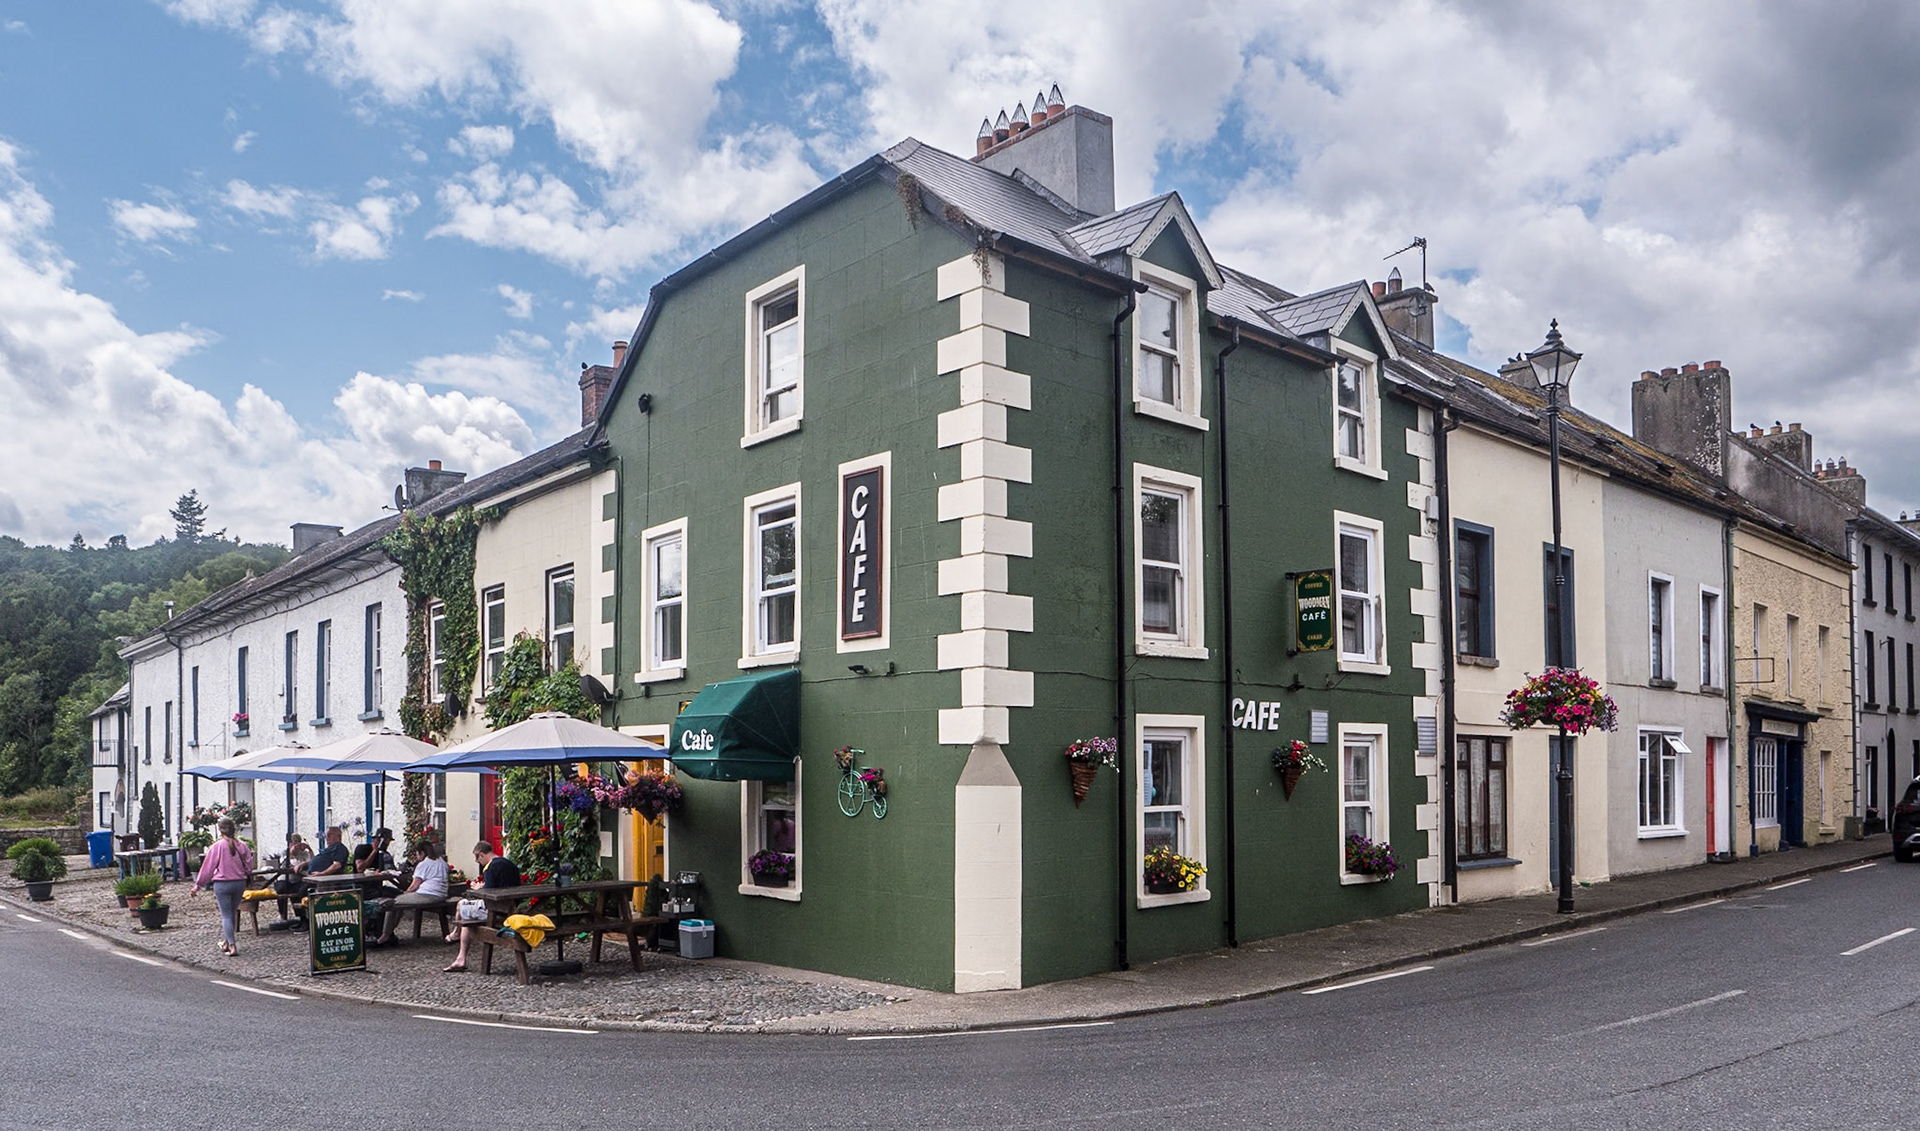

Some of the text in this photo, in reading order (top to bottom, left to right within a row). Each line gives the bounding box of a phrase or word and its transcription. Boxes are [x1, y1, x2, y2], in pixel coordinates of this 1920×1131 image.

[849, 485, 869, 623] CAFE
[1232, 698, 1280, 730] CAFE
[681, 728, 714, 750] Cafe
[315, 909, 359, 928] WOODMAN
[321, 946, 340, 954] TAKE
